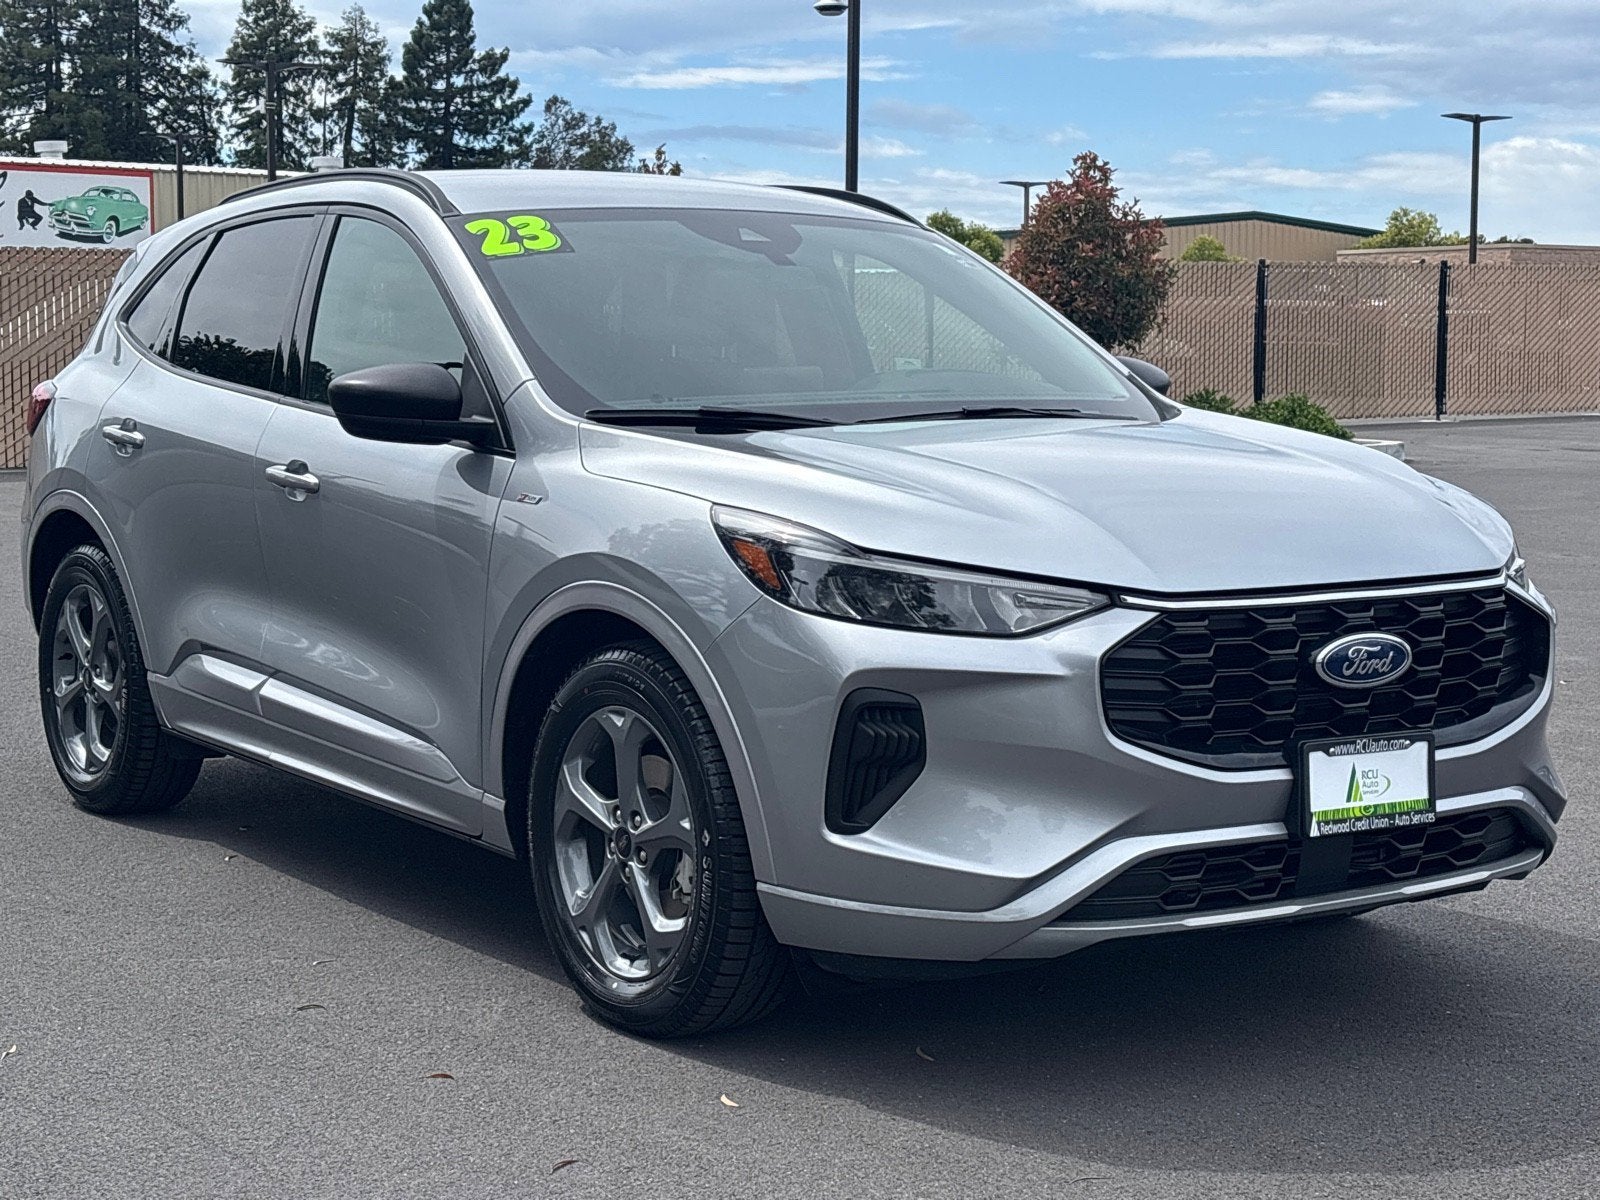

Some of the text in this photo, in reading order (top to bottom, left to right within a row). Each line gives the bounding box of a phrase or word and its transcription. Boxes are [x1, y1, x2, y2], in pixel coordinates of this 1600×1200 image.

[465, 215, 561, 256] 23
[1342, 645, 1393, 676] Ford
[1335, 738, 1405, 755] www.RCUauto.com
[1361, 769, 1379, 780] RCU
[1362, 780, 1379, 789] Auto
[1320, 819, 1350, 835] Redwood
[1350, 818, 1369, 832] Credit
[1370, 816, 1389, 829] Union
[1395, 813, 1410, 826] Auto
[1411, 811, 1436, 825] Services
